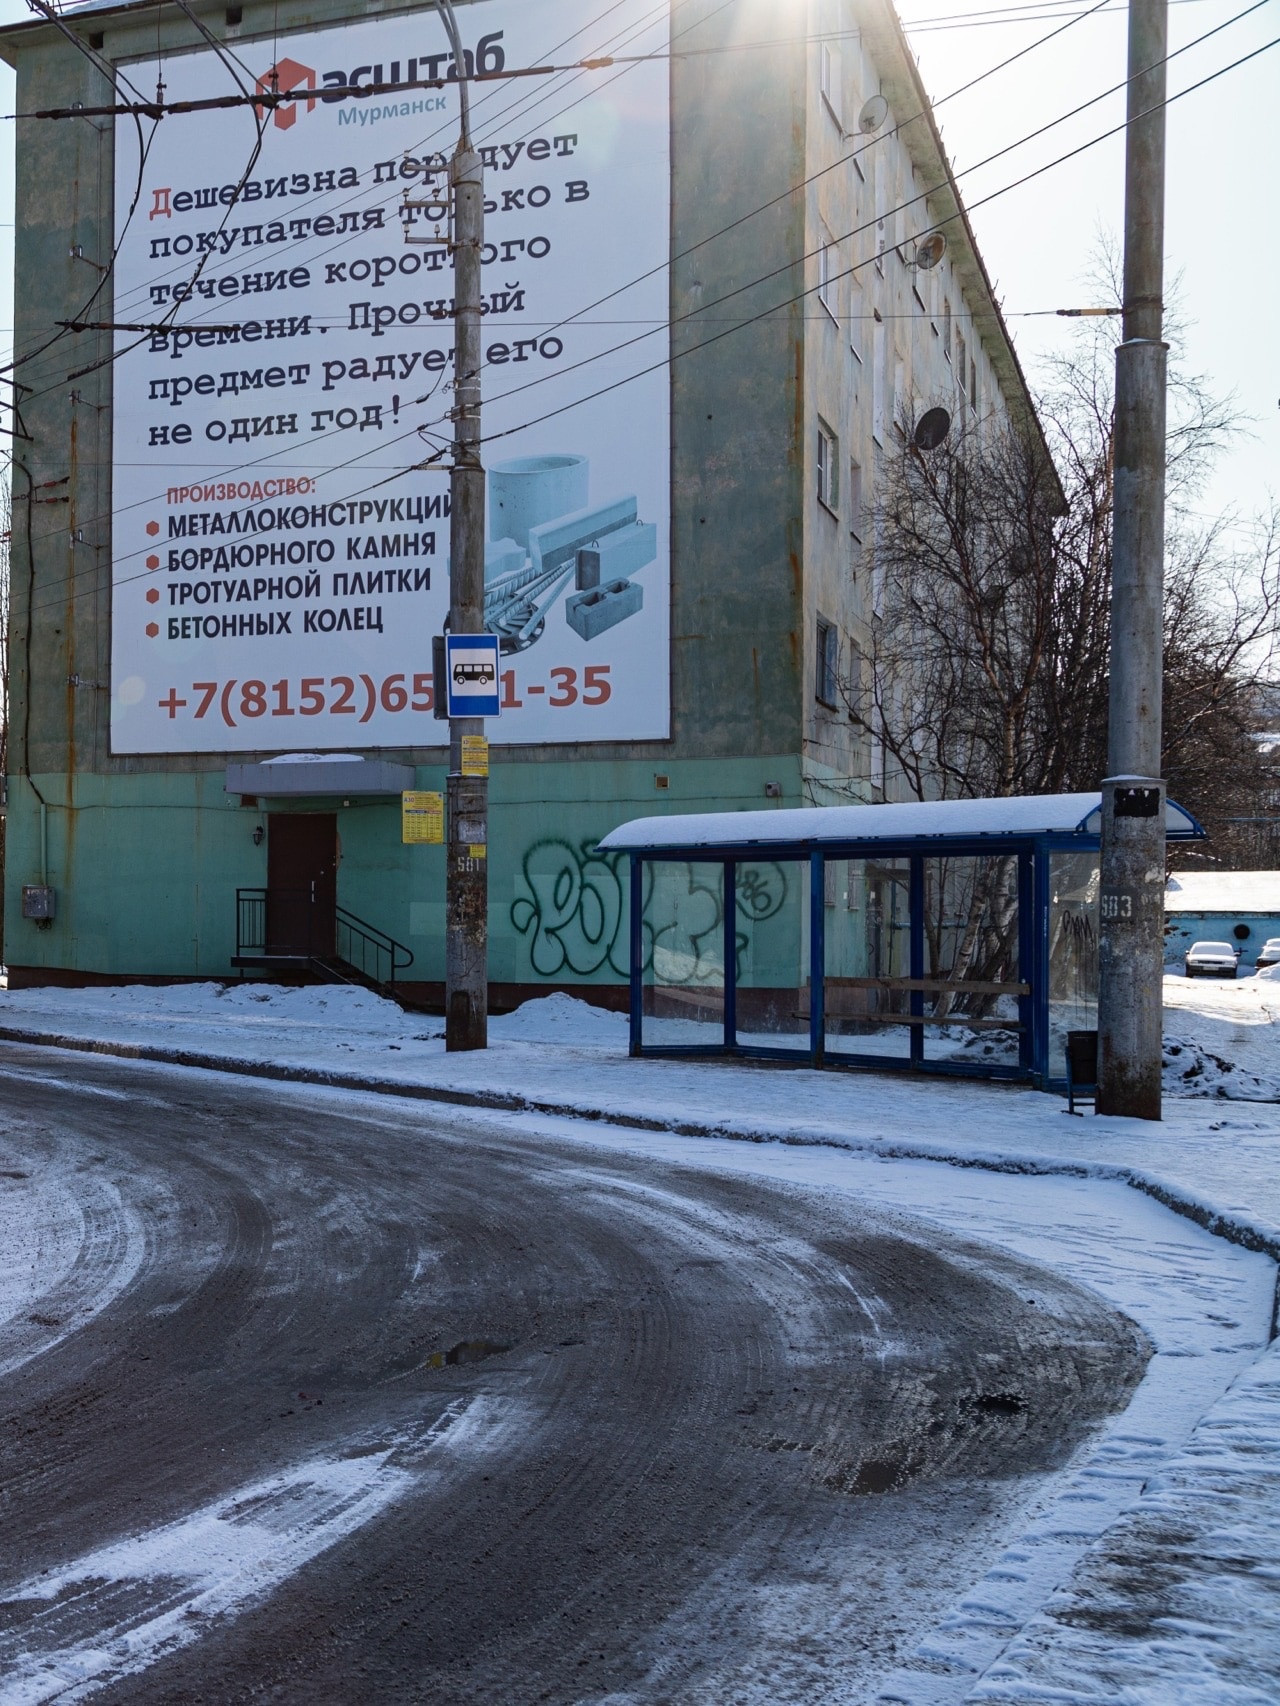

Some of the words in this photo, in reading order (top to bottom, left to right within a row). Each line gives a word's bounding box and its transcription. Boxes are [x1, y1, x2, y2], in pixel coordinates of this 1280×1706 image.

[338, 96, 447, 127] Мурманск
[150, 167, 360, 220] Дешевизна
[373, 134, 577, 185] пордует
[150, 208, 385, 258] покупателя
[565, 180, 590, 203] в
[150, 267, 310, 305] течение
[325, 237, 551, 287] коротого
[148, 364, 310, 406] предмет
[486, 337, 563, 365] его
[148, 423, 192, 446] не
[205, 413, 298, 444] один
[311, 395, 401, 432] год!
[167, 477, 316, 504] ПРОИЗВОДСТВО:
[168, 538, 335, 573] БОРДЮРНОГО
[347, 531, 436, 560] КАМНЯ
[167, 569, 321, 605] ТРОТУАРНОЙ
[333, 567, 431, 596] ПЛИТКИ
[168, 611, 292, 640] БЕТОННЫХ
[304, 606, 383, 633] КОЛЕЦ
